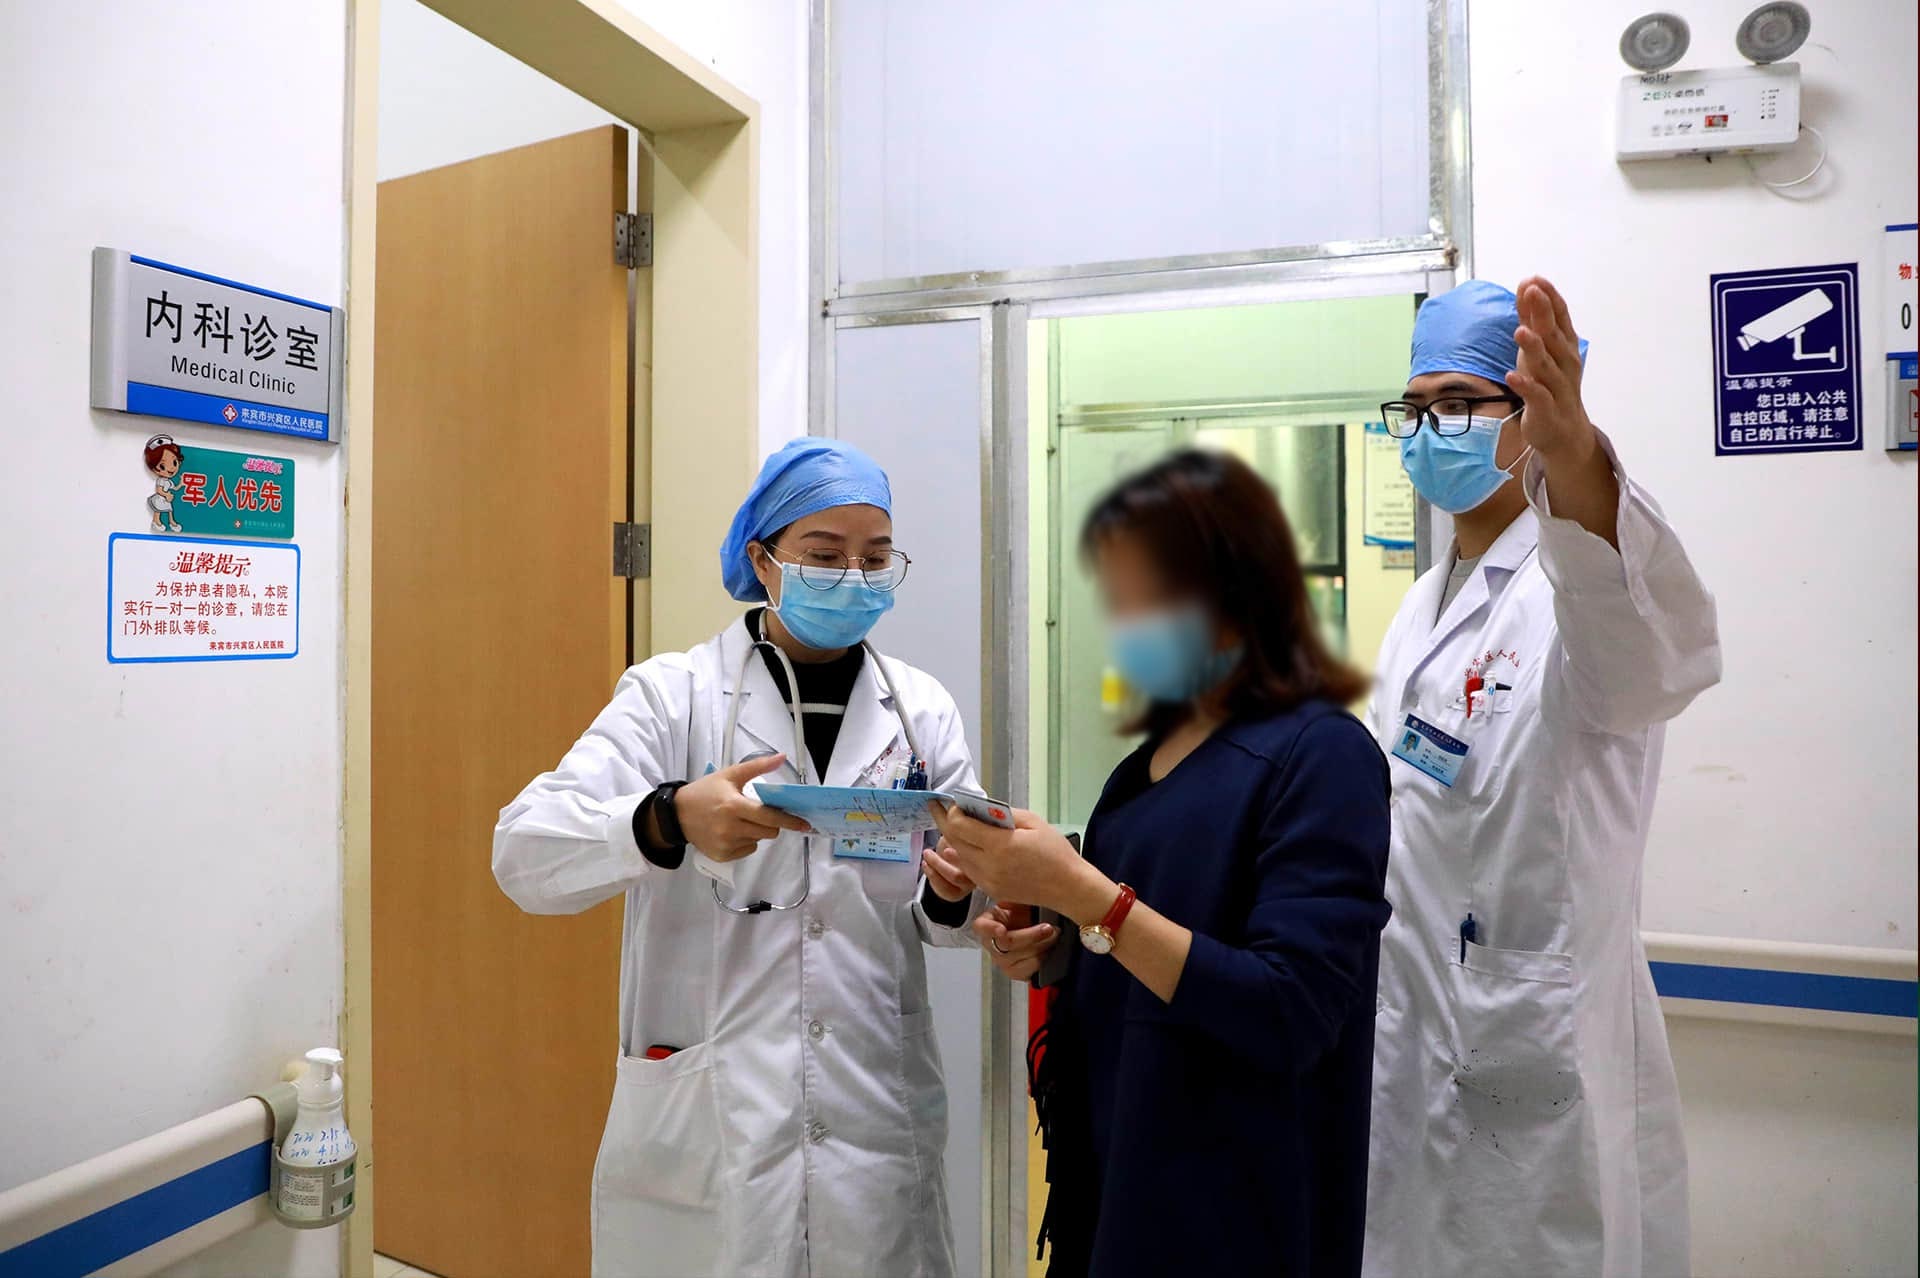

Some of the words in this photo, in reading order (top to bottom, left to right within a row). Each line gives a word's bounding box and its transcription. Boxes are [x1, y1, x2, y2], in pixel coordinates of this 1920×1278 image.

[1899, 263, 1918, 280] 物
[145, 290, 319, 371] 内科诊室
[171, 355, 244, 385] Medical
[249, 370, 296, 395] Clinic
[1725, 377, 1792, 390] 温馨提示
[1757, 389, 1847, 408] 您已进入公共
[181, 472, 283, 513] 军人优先
[169, 551, 252, 578] 温馨提示
[155, 581, 288, 599] 为保护患者隐私，本院
[123, 600, 288, 617] 实行一对一的诊查，请您在
[123, 619, 217, 636] 门外排队等候。
[209, 640, 285, 650] 来宾市兴宾区人民医院
